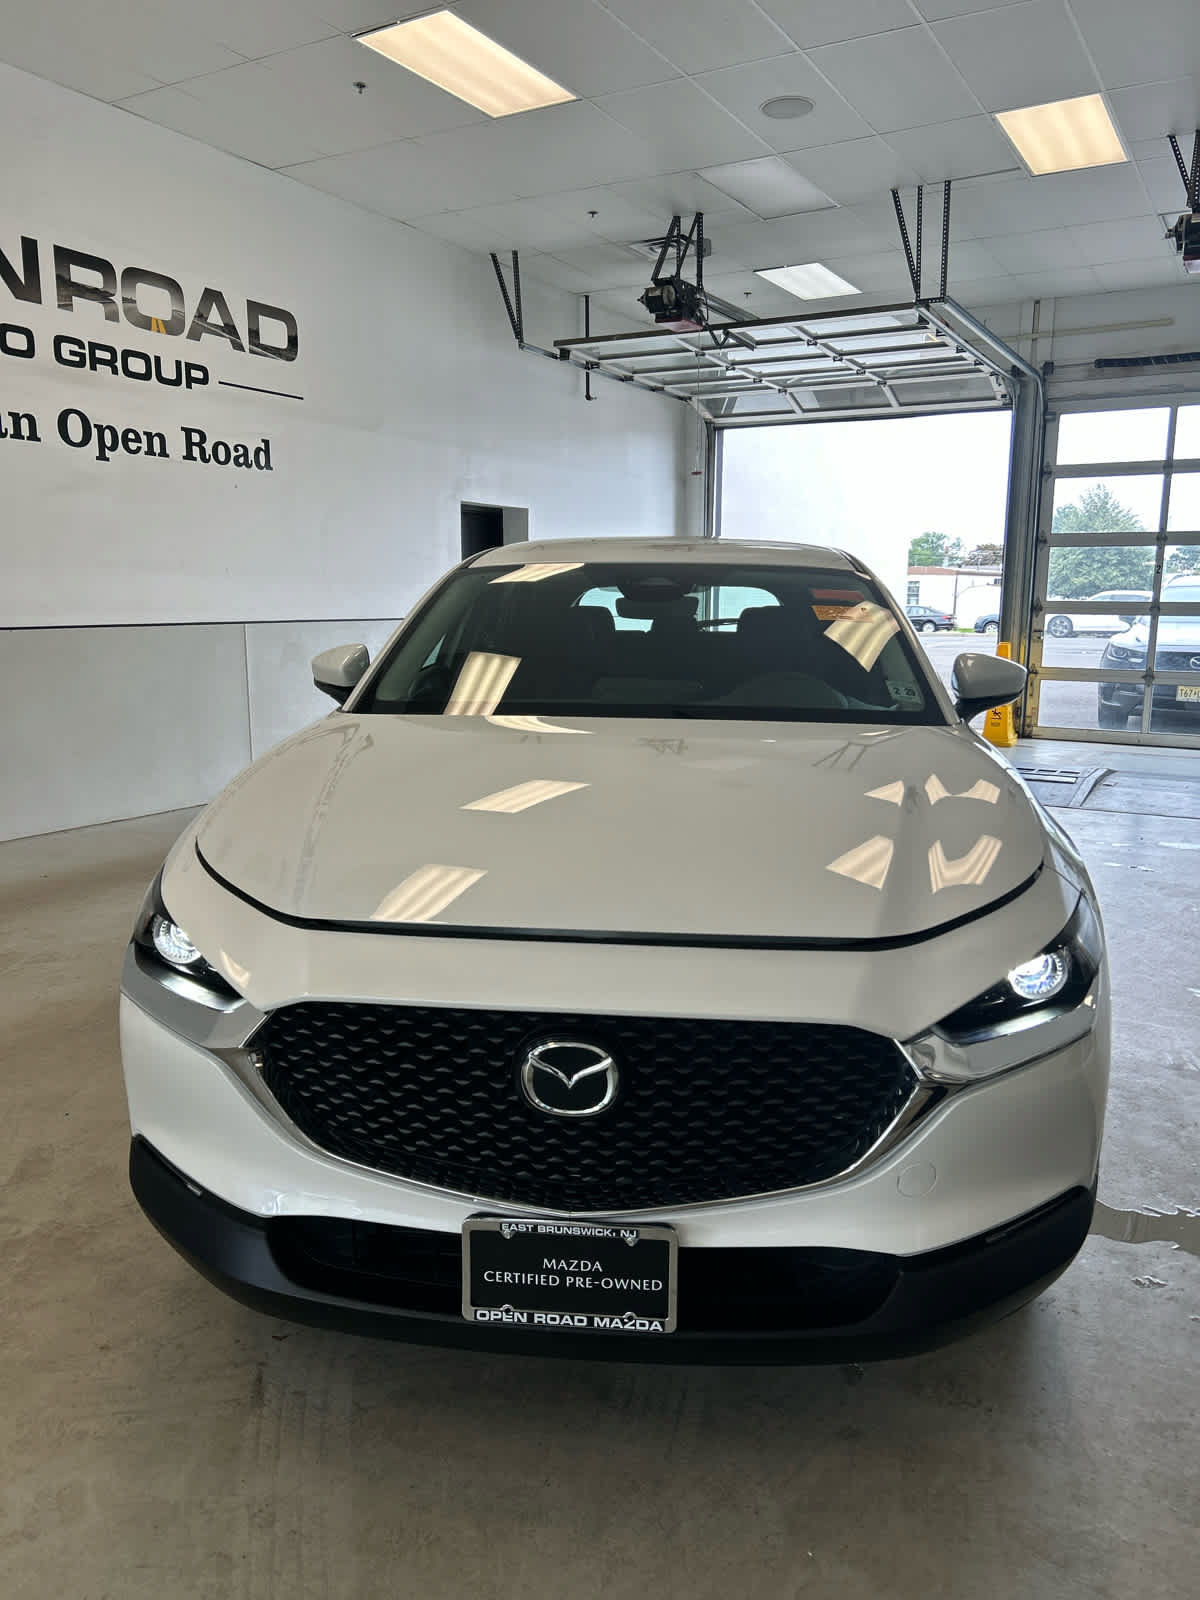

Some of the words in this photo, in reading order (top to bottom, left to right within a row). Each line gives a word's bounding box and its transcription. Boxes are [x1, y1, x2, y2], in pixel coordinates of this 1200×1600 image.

[53, 334, 209, 389] GROUP
[0, 410, 41, 442] n
[57, 408, 170, 461] Open
[180, 426, 273, 471] Road
[501, 1223, 534, 1233] EAST
[537, 1224, 616, 1237] BRUNSWICK,
[620, 1229, 638, 1238] NJ
[543, 1258, 603, 1272] MAZDA
[483, 1271, 560, 1286] CERTIFIED
[566, 1277, 663, 1291] PRE-OWNED
[476, 1310, 528, 1323] OPEN
[533, 1313, 588, 1327] ROAD
[594, 1316, 664, 1332] MAZDA
